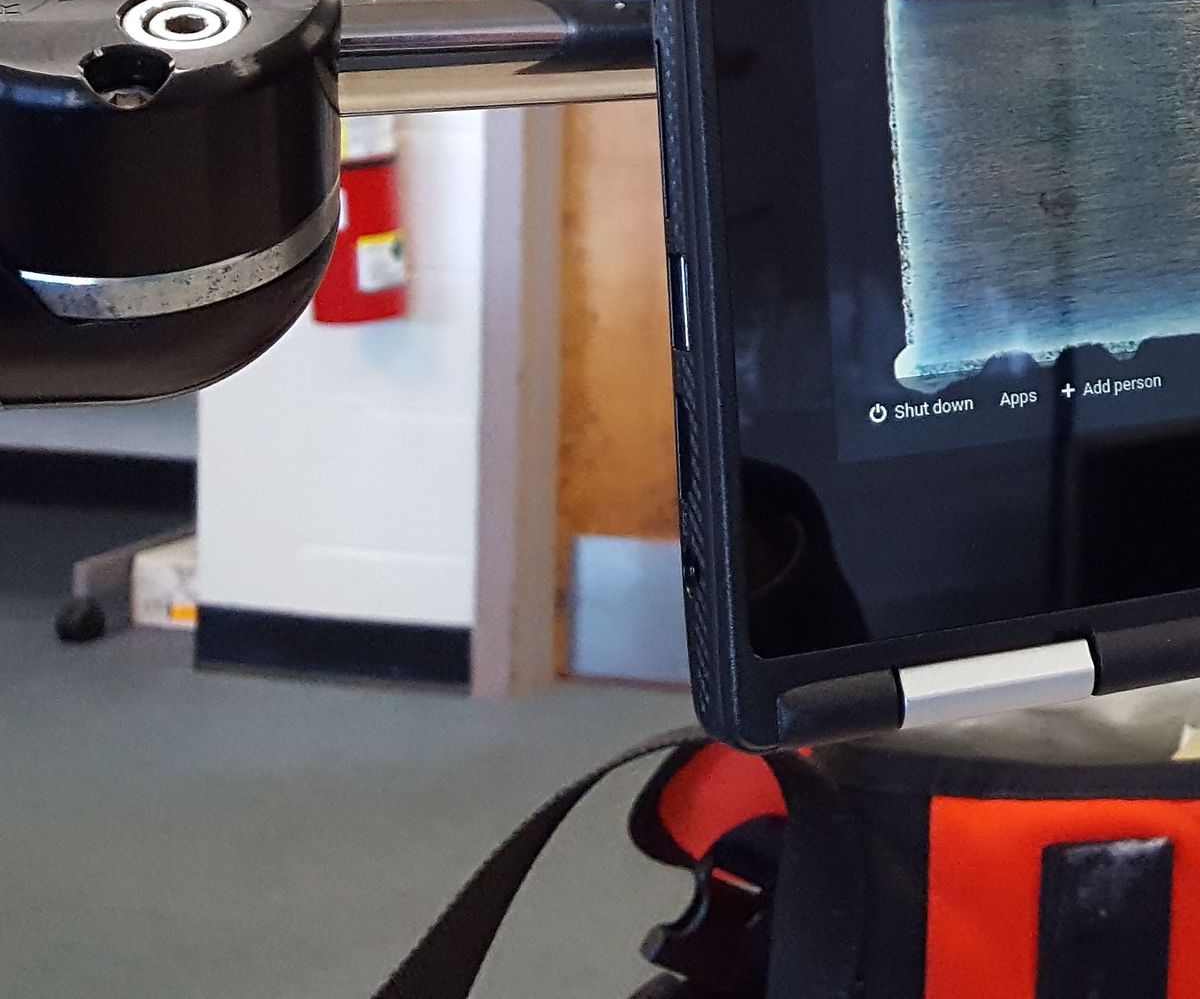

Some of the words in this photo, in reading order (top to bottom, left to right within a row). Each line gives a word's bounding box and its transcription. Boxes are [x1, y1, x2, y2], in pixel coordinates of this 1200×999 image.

[1082, 380, 1111, 396] Add
[1113, 375, 1162, 395] person
[894, 401, 930, 419] Shut
[932, 397, 974, 414] down
[999, 390, 1038, 408] Apps
